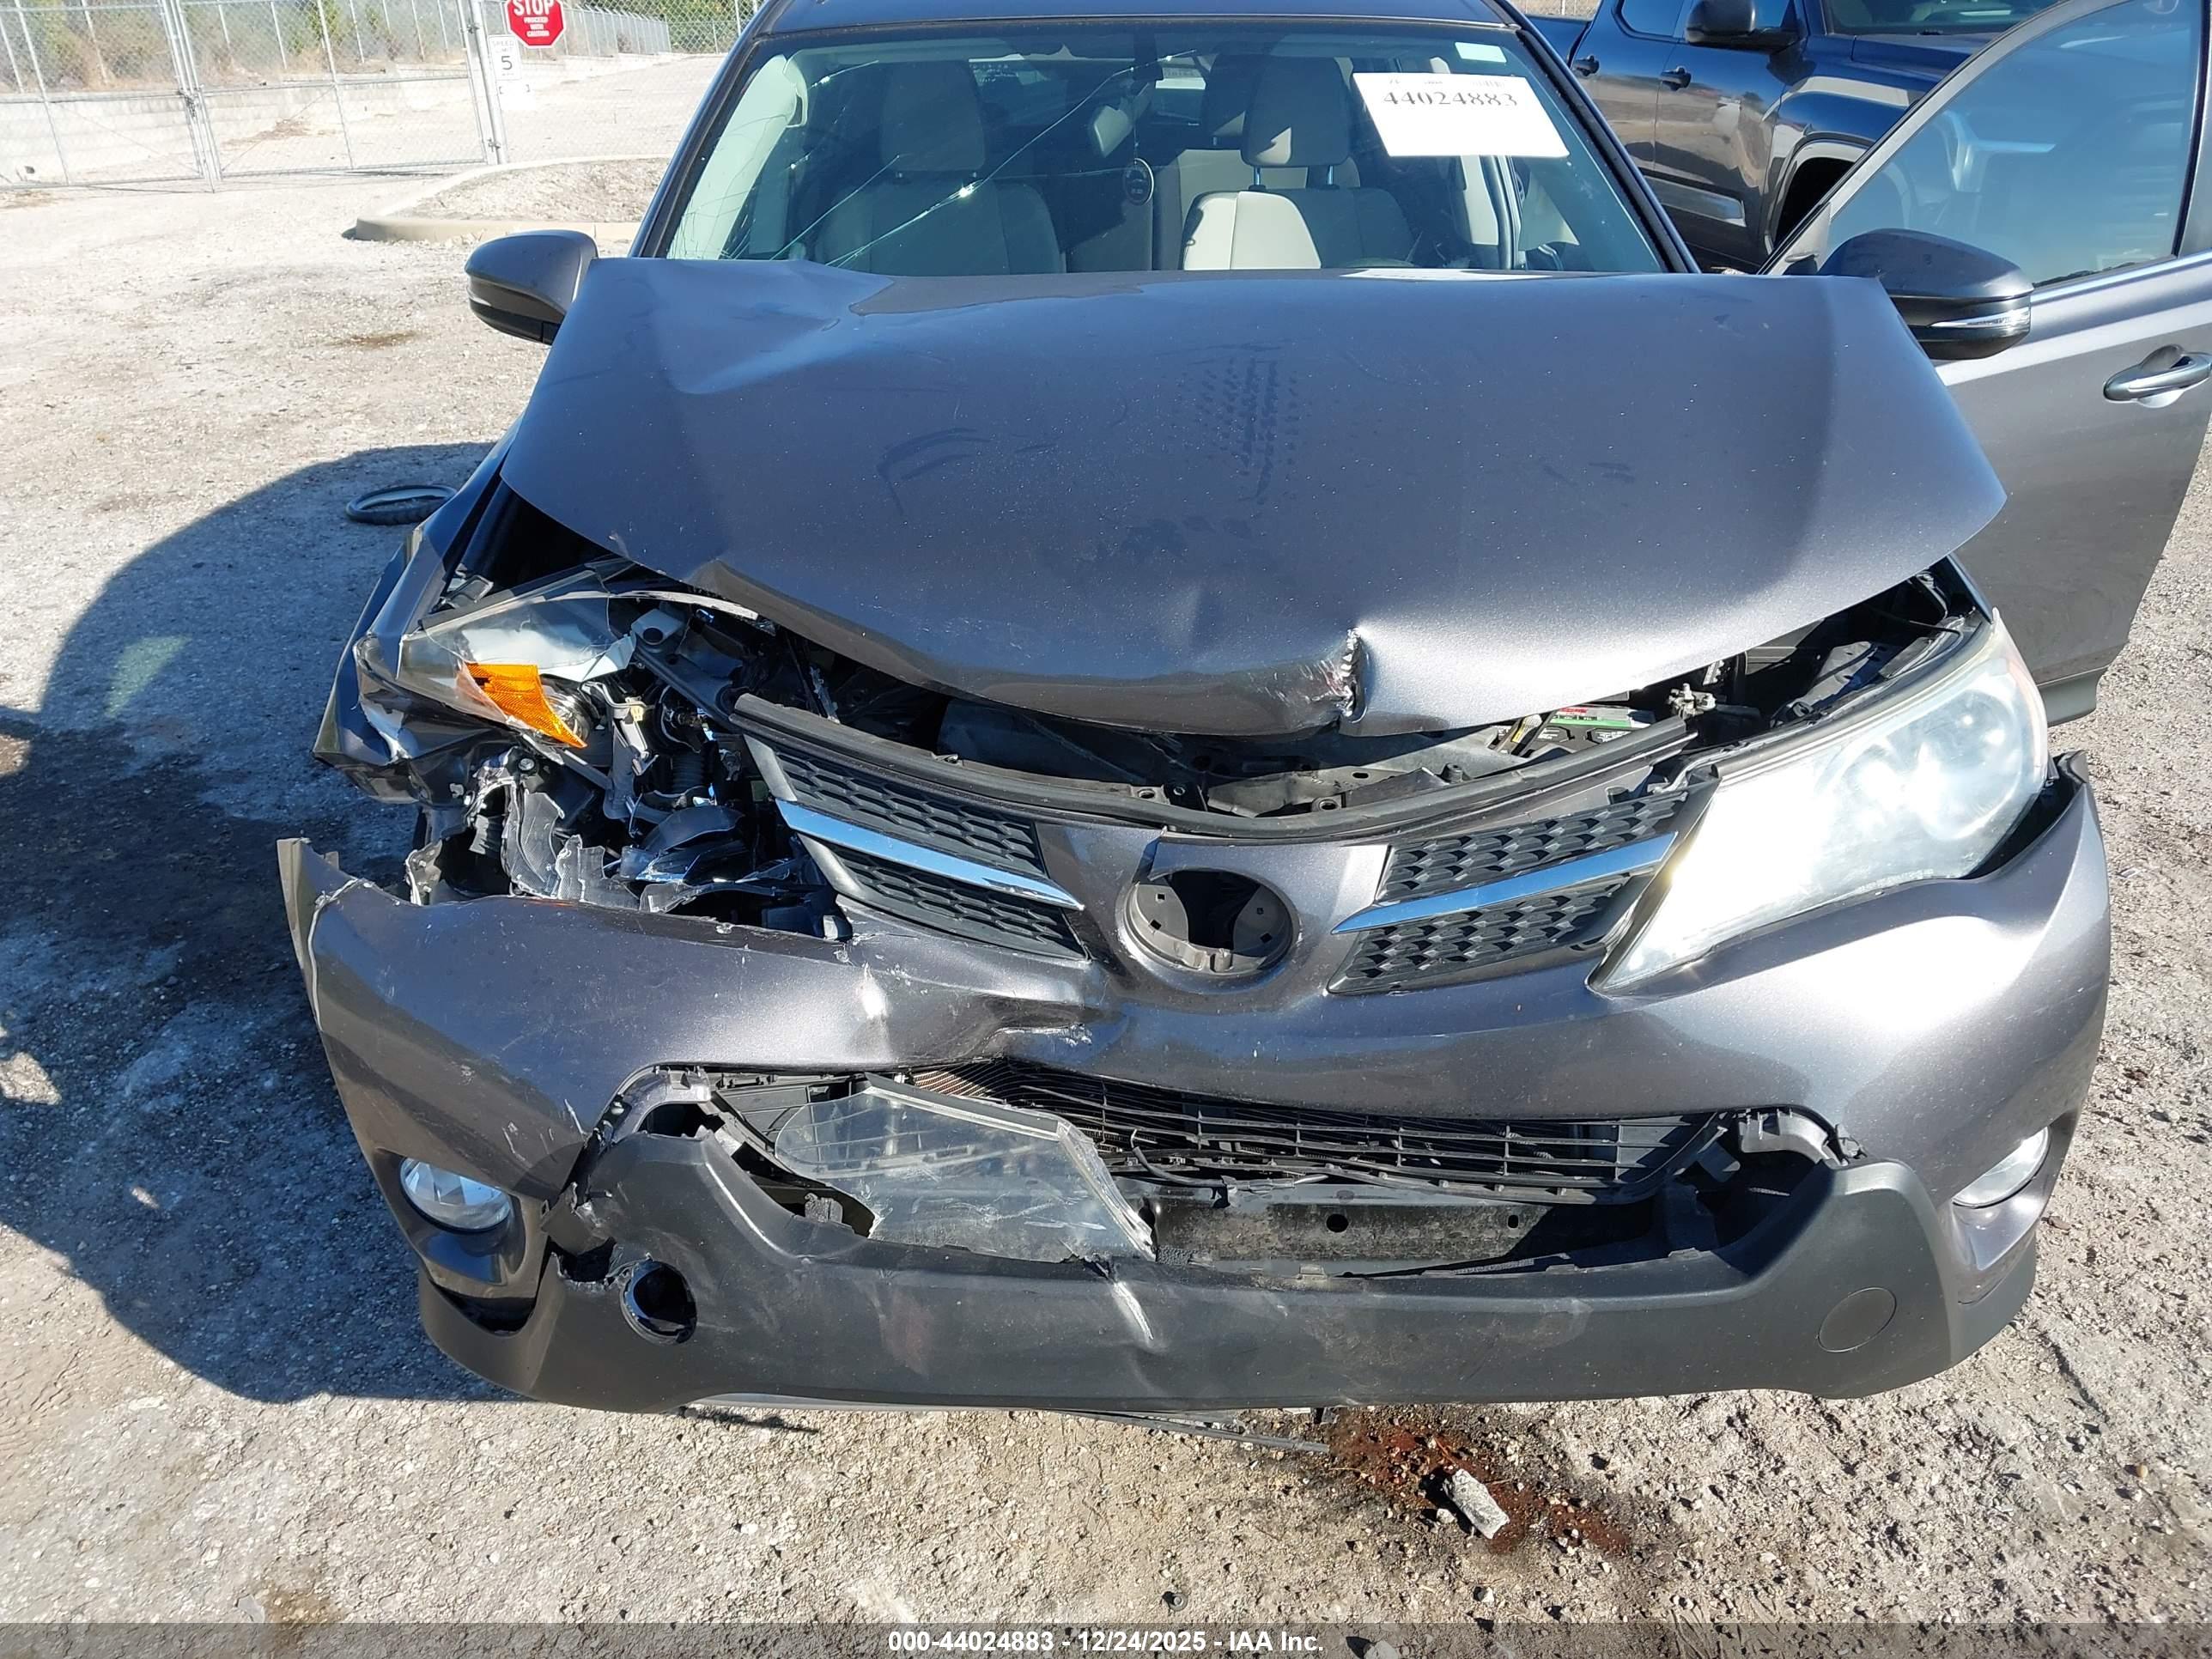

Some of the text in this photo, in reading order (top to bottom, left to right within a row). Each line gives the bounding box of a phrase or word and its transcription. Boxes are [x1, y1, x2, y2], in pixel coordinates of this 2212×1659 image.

[513, 0, 554, 15] STOP
[501, 56, 513, 70] 5
[1382, 91, 1518, 106] 44024883
